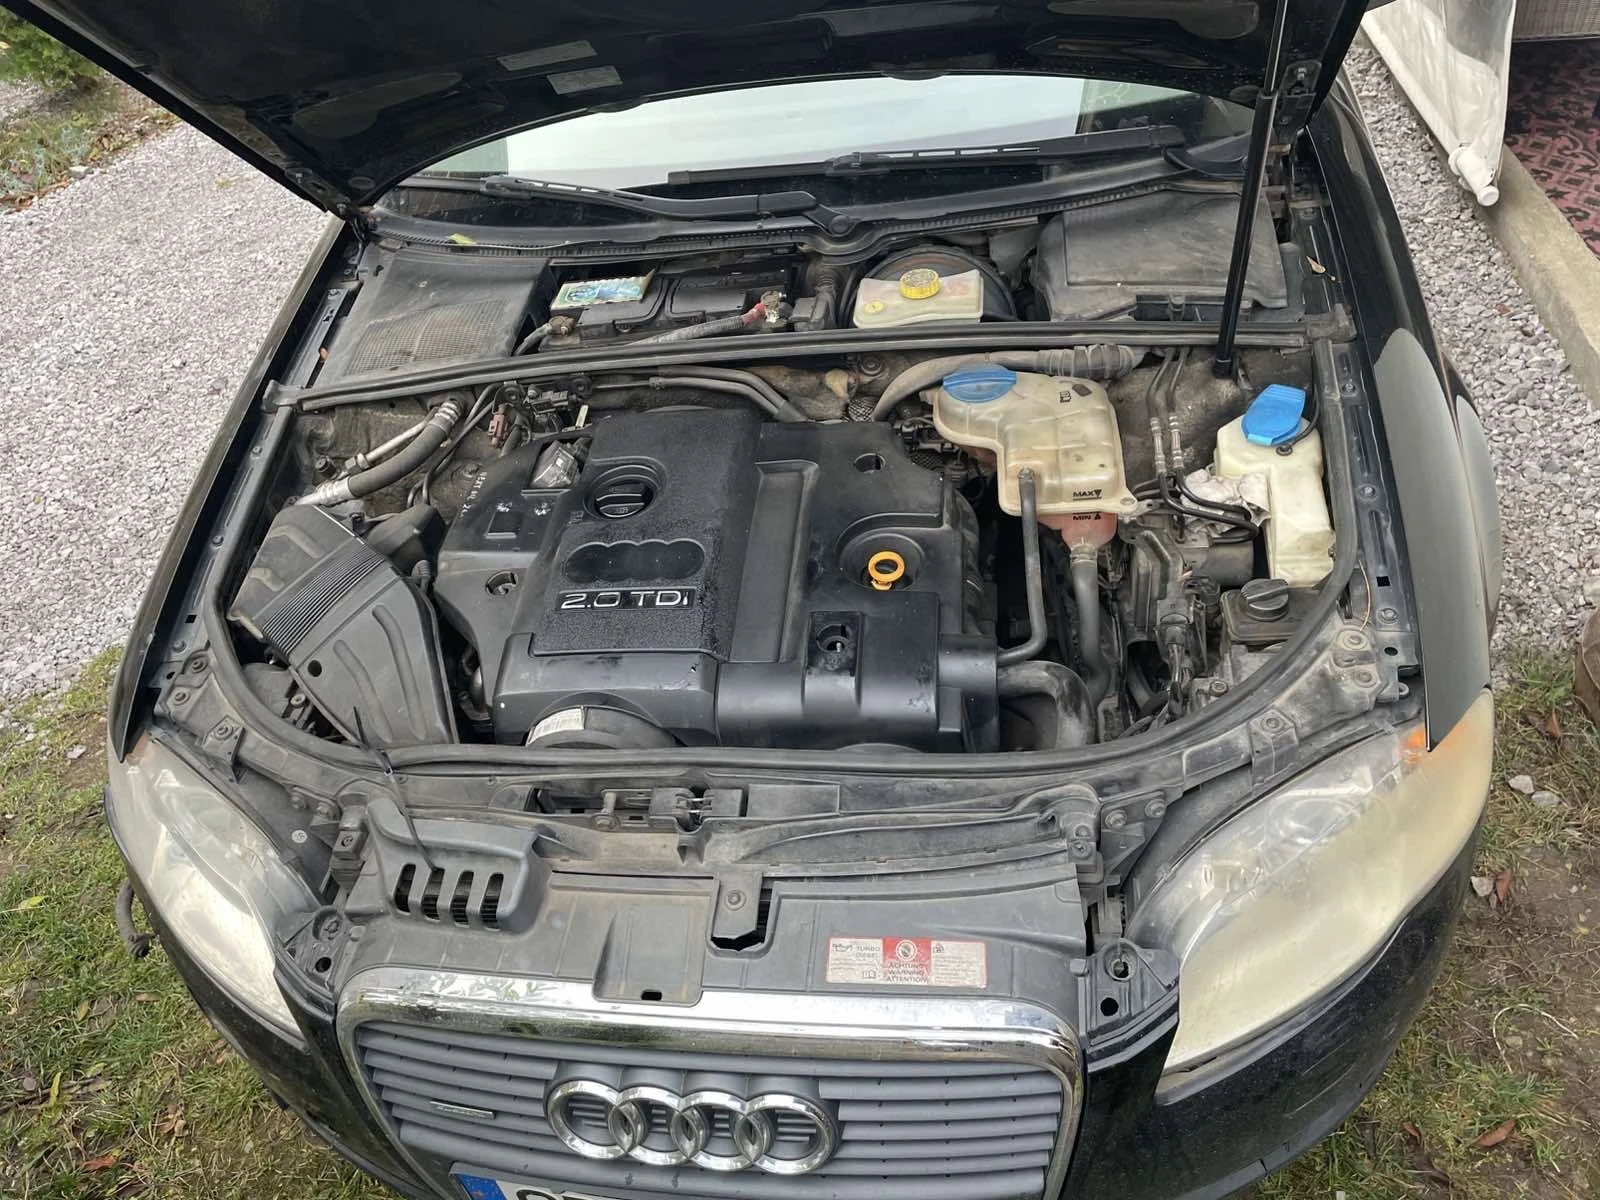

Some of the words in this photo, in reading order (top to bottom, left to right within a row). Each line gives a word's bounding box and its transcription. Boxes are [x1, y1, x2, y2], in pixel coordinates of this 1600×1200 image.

[560, 592, 621, 609] 2.0
[888, 961, 924, 969] ACHTUNG
[888, 968, 925, 976] WARNING
[886, 975, 929, 983] ATTENTION
